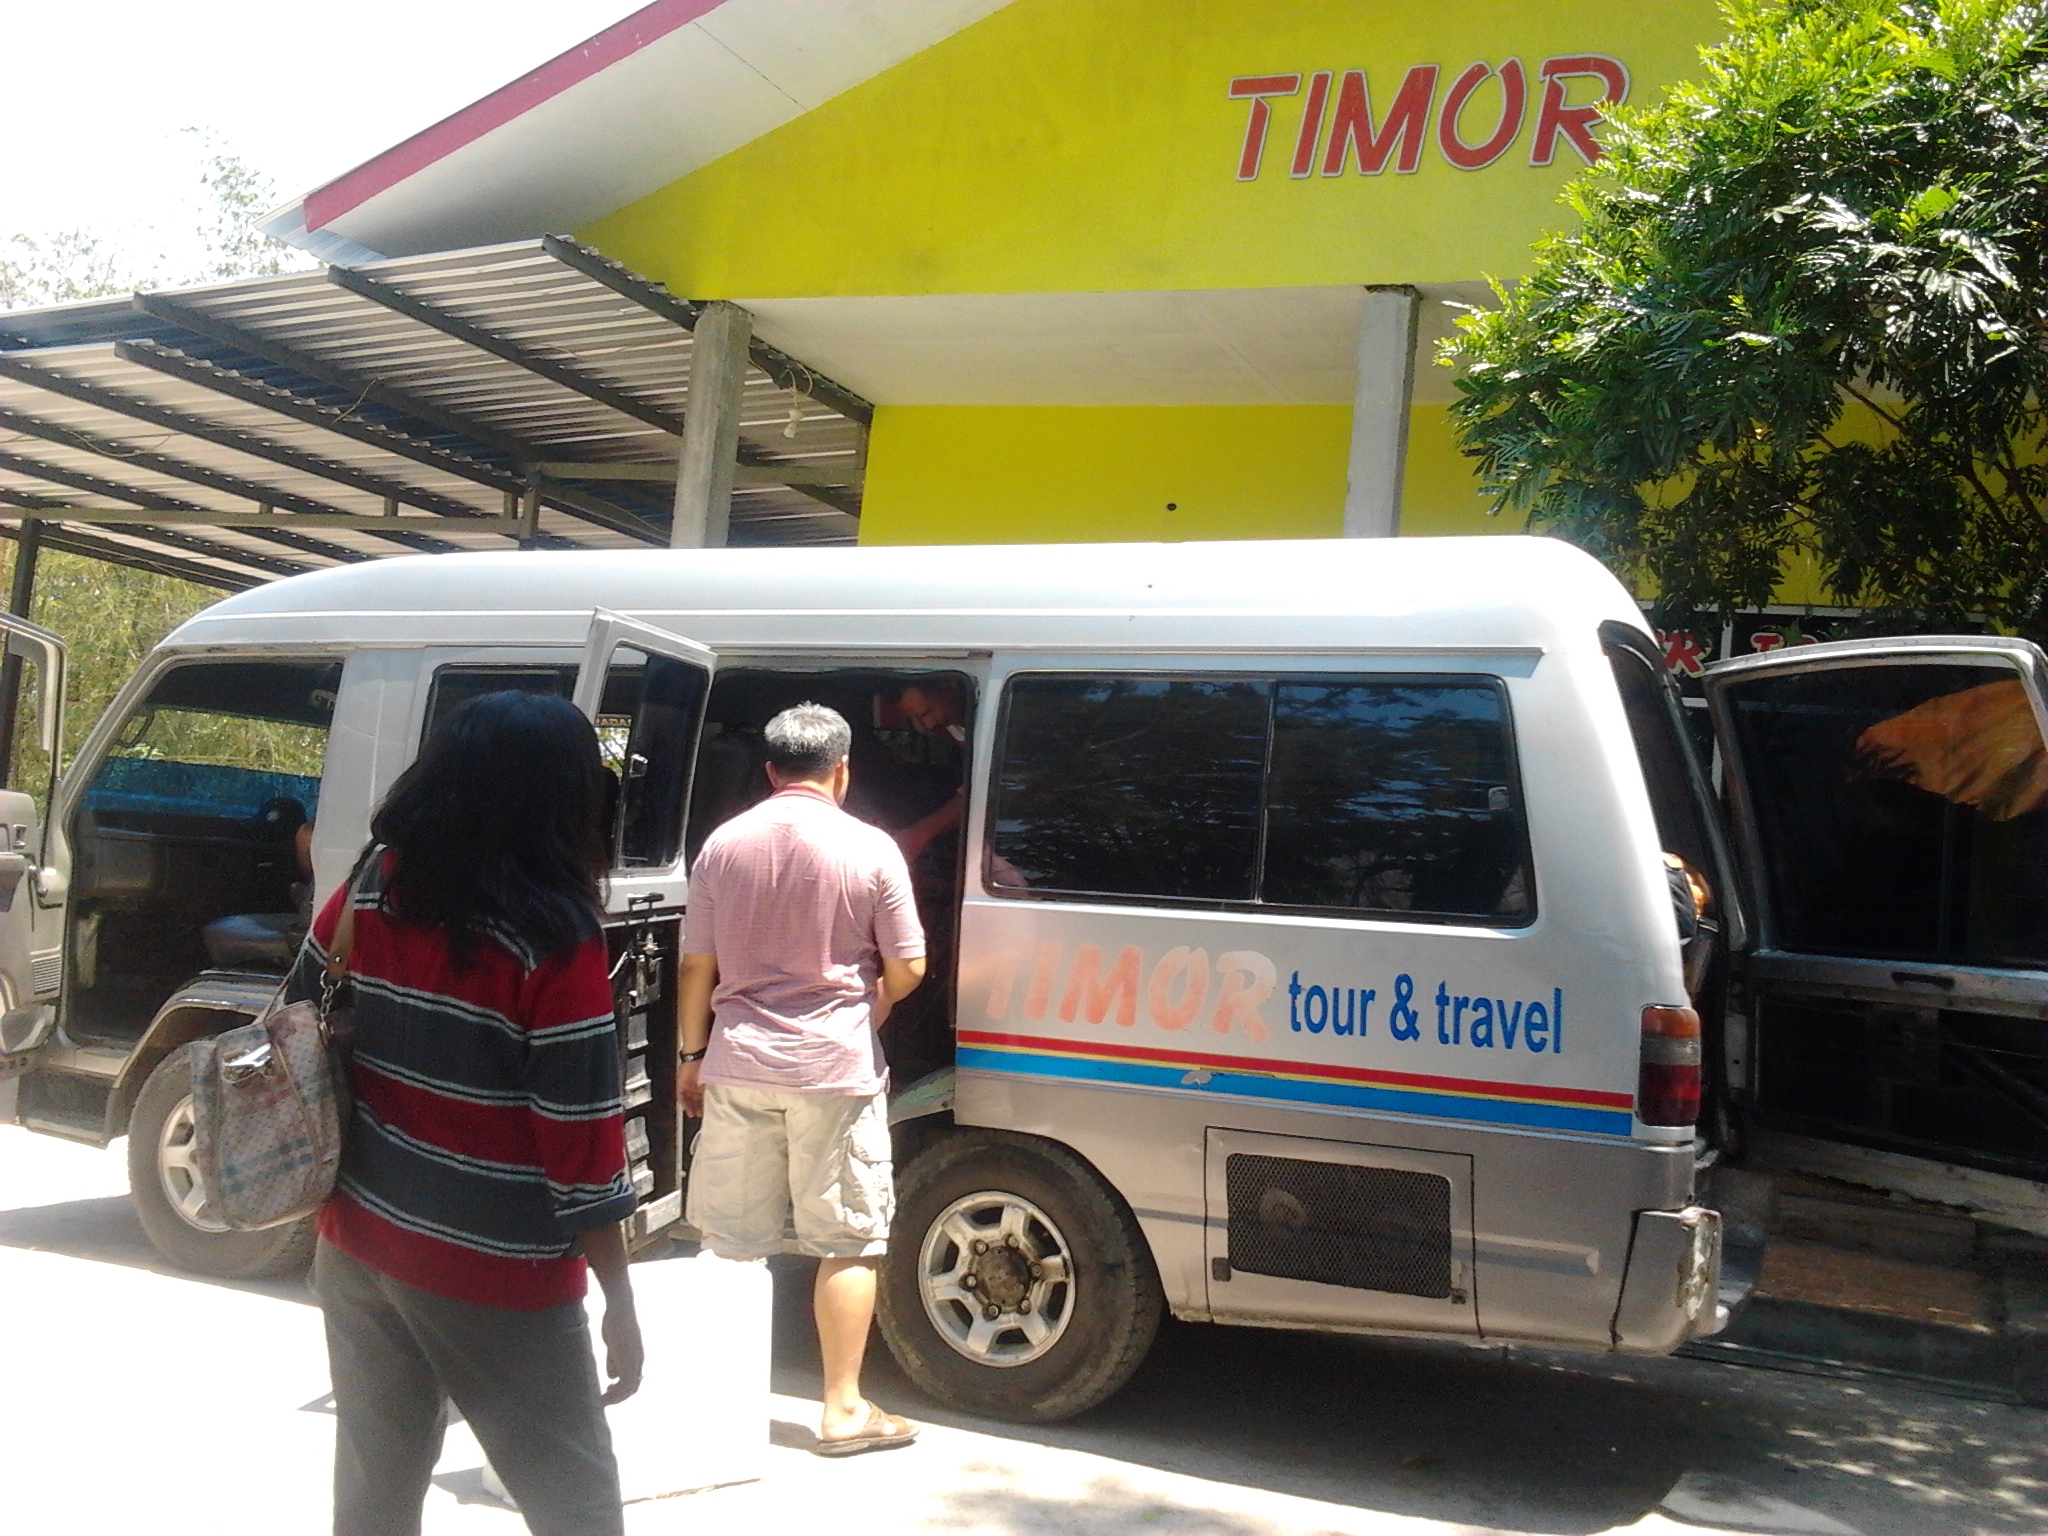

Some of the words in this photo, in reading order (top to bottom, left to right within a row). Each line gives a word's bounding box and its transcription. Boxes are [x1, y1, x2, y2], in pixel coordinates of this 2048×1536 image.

[1228, 53, 1631, 181] TIMOR
[978, 940, 1277, 1044] TIMOR
[1288, 970, 1376, 1037] tour
[1389, 973, 1421, 1042] &
[1435, 979, 1563, 1054] travel
